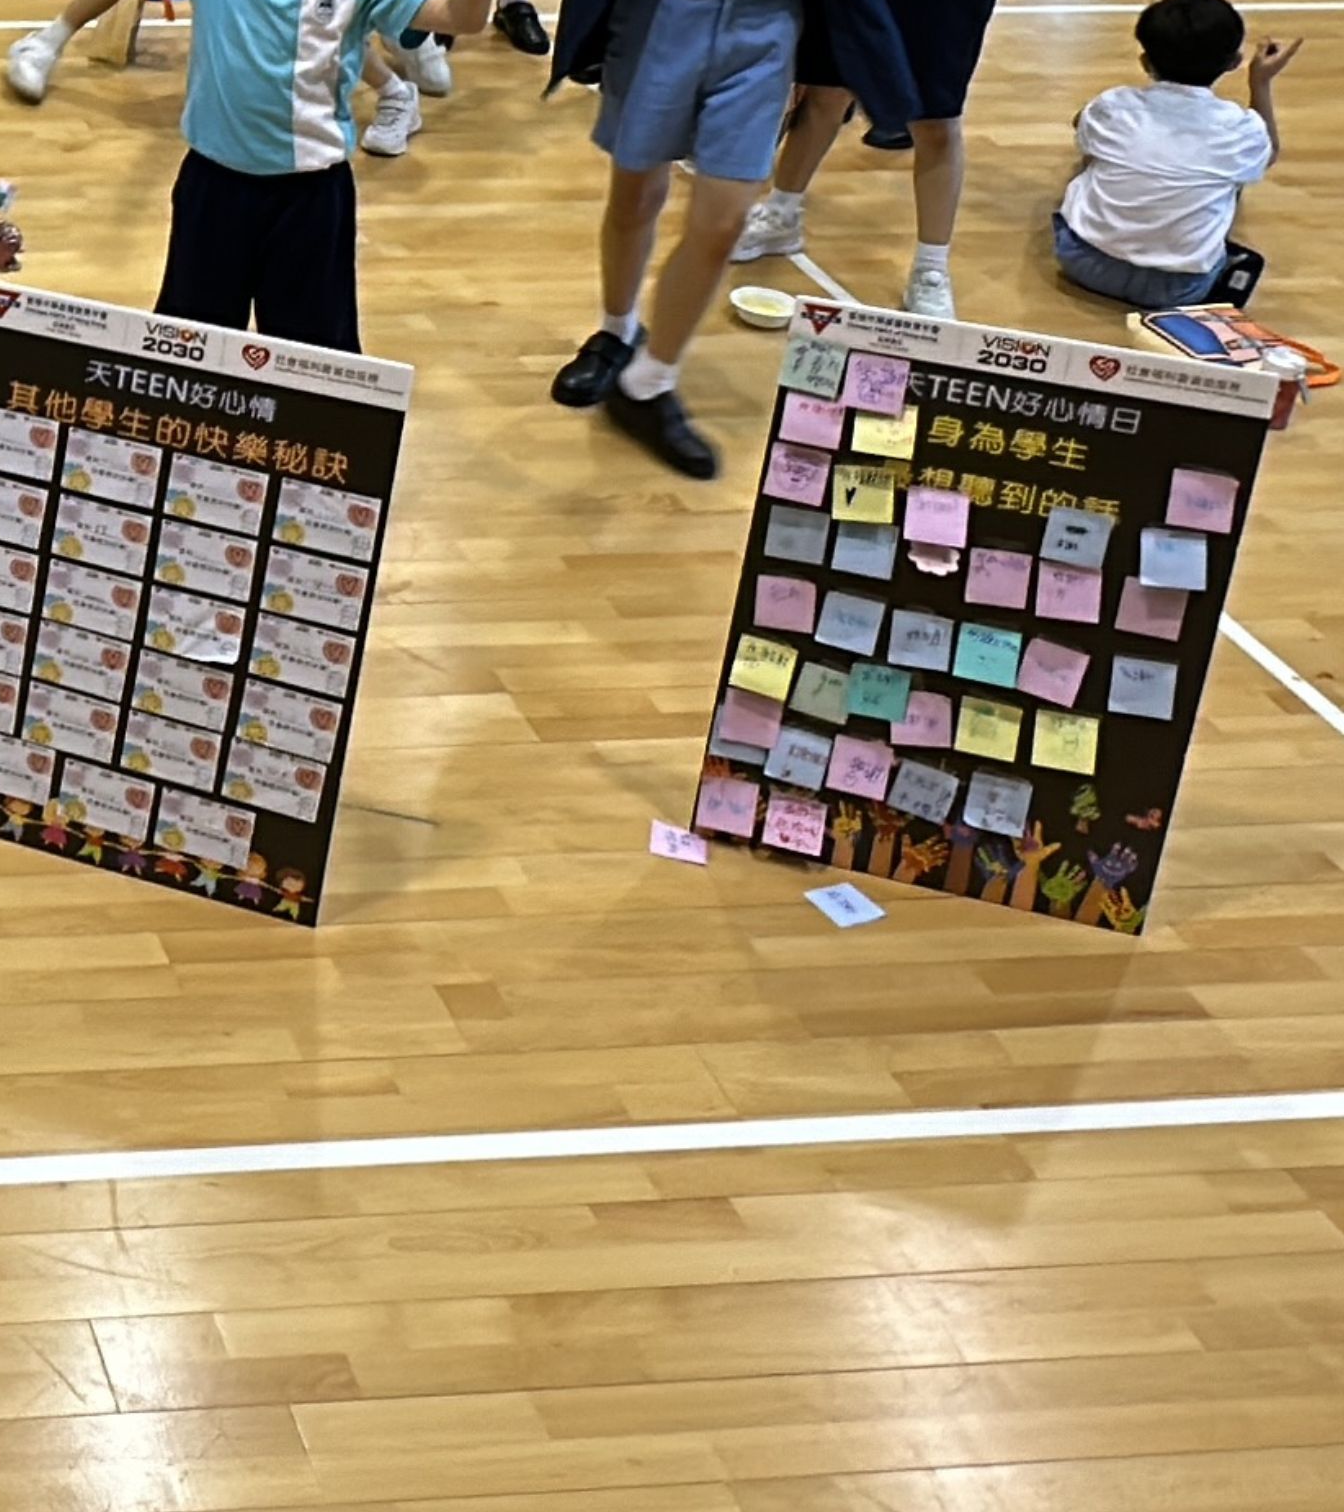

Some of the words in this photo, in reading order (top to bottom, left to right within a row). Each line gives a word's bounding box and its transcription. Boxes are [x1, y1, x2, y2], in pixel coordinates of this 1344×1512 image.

[145, 320, 208, 347] VISION
[981, 333, 1052, 359] VISION
[141, 336, 205, 362] 2030
[976, 349, 1048, 375] 2030
[926, 415, 1090, 473] 身為學生
